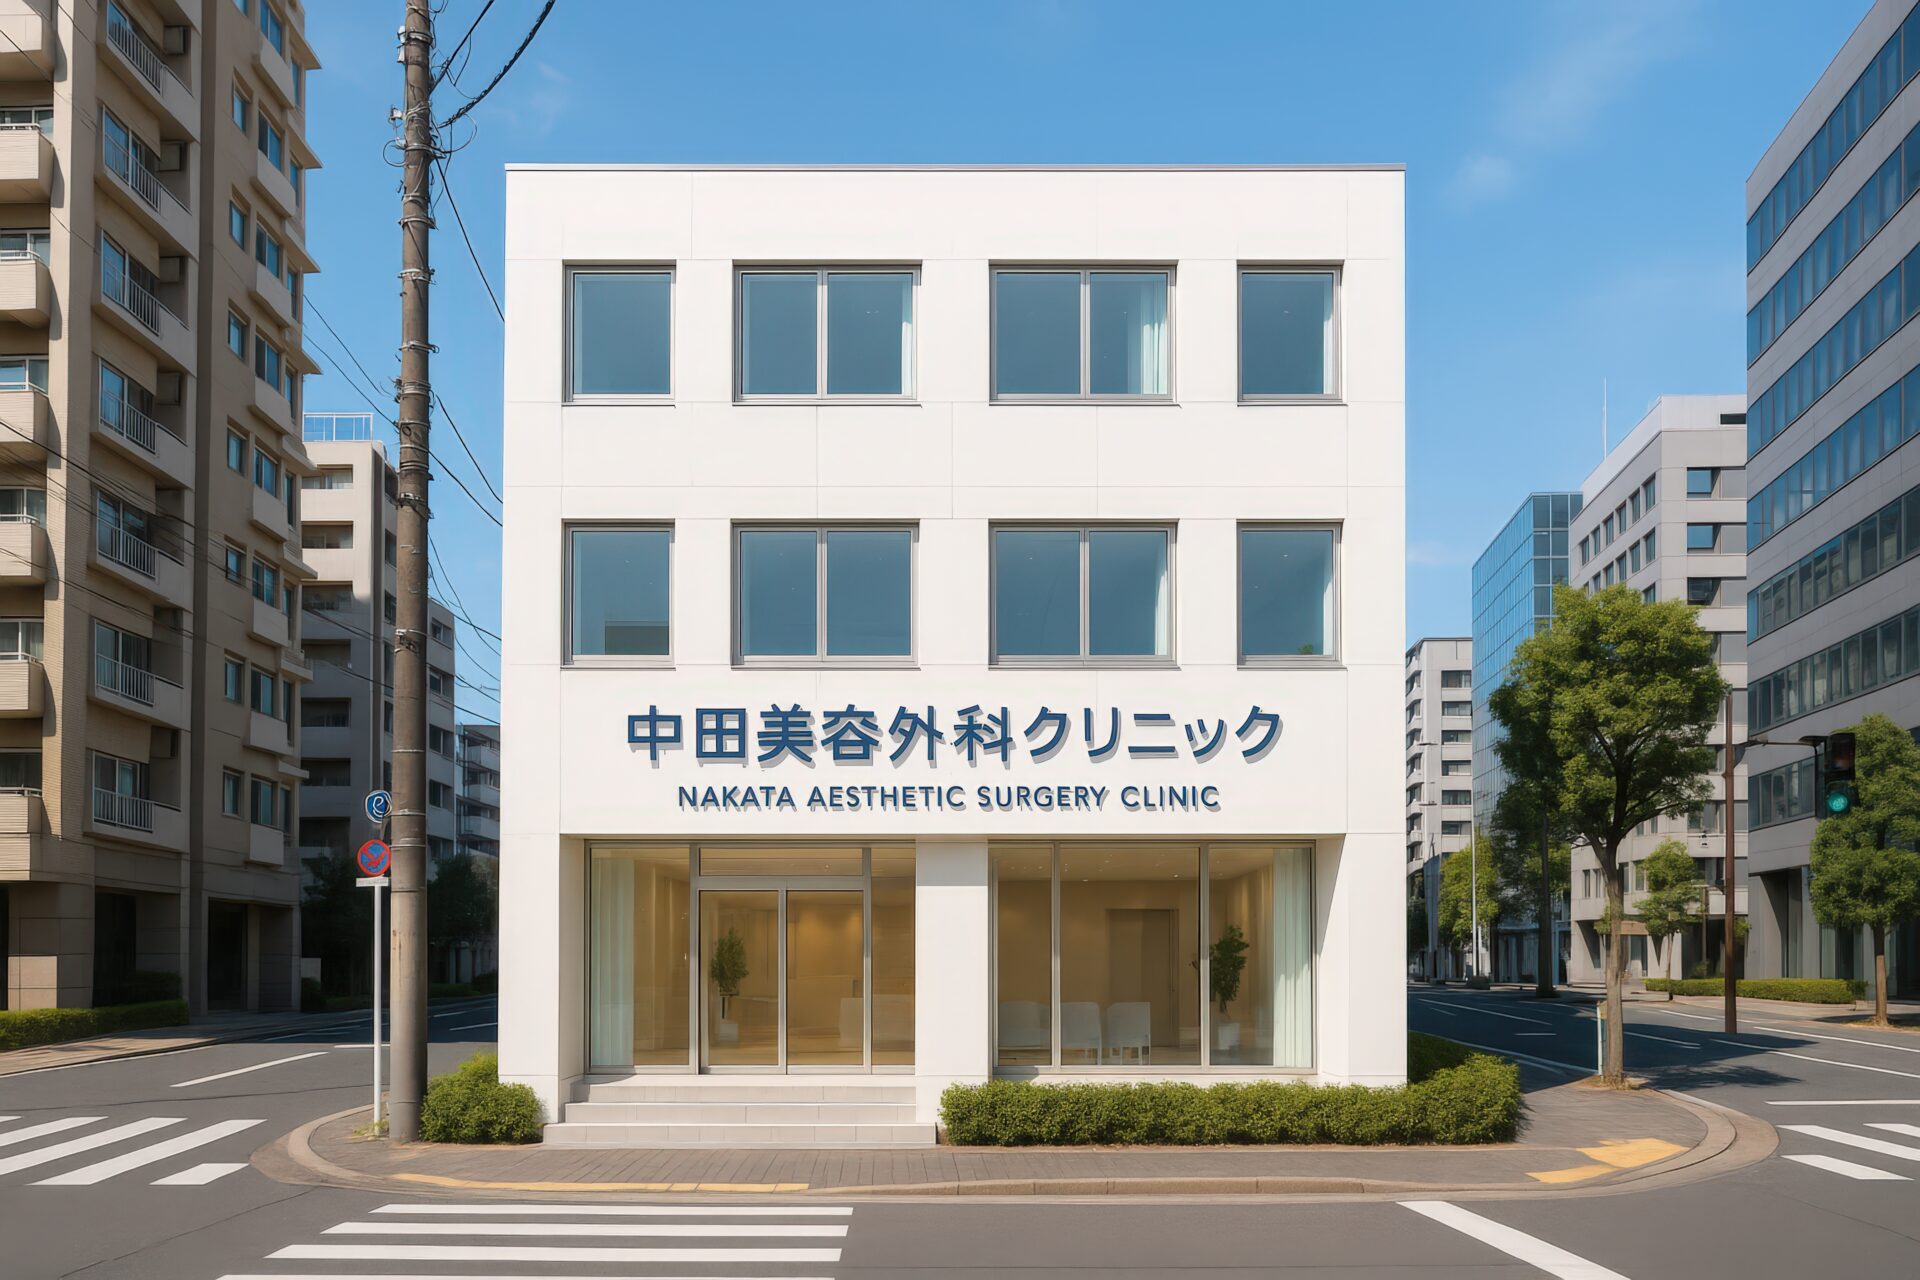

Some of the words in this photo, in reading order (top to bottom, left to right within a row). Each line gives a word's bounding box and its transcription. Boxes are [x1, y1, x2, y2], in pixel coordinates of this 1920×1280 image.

[627, 704, 1280, 762] 中田美容外科クリニック
[678, 786, 795, 807] NAKATA
[807, 786, 965, 807] AESTHETIC
[977, 786, 1106, 807] SURGERY
[1121, 786, 1218, 807] CLINIC
